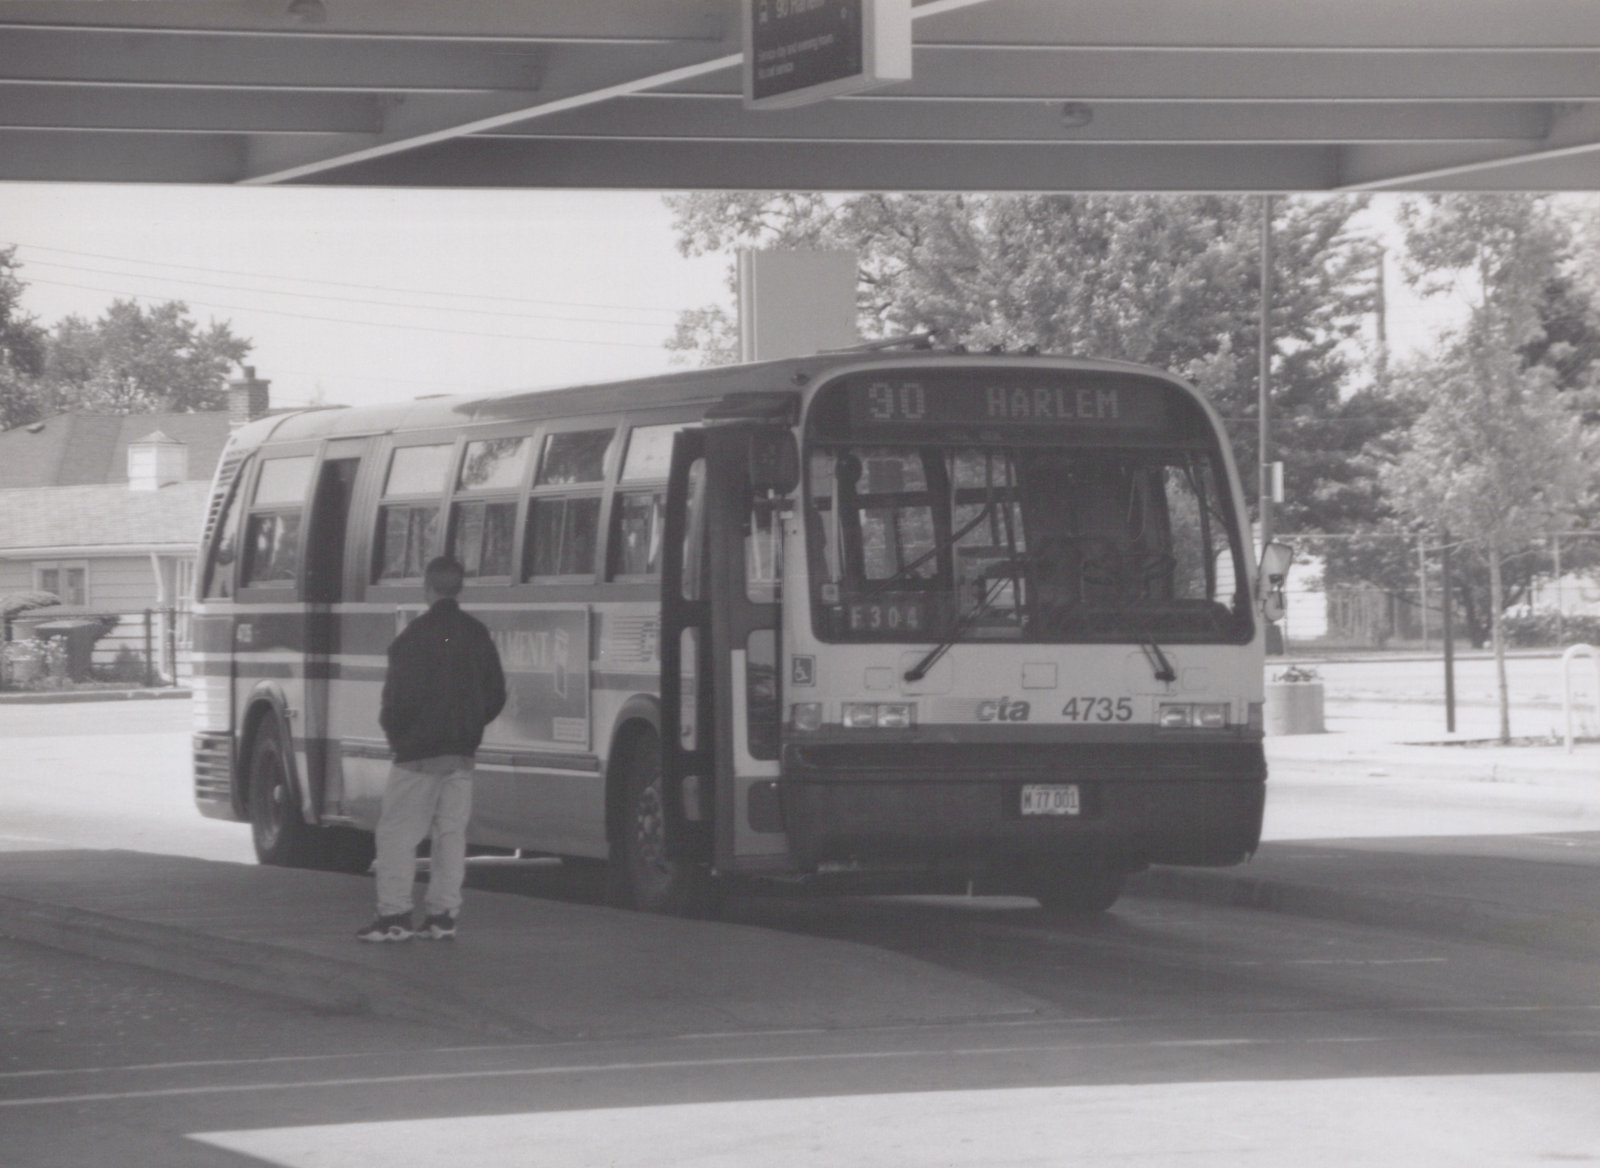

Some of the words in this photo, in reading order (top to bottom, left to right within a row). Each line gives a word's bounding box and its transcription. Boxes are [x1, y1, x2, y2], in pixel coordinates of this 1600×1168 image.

[868, 382, 925, 419] 90
[987, 387, 1119, 418] HARLEM
[976, 696, 1031, 722] cta
[1062, 697, 1133, 722] 4735
